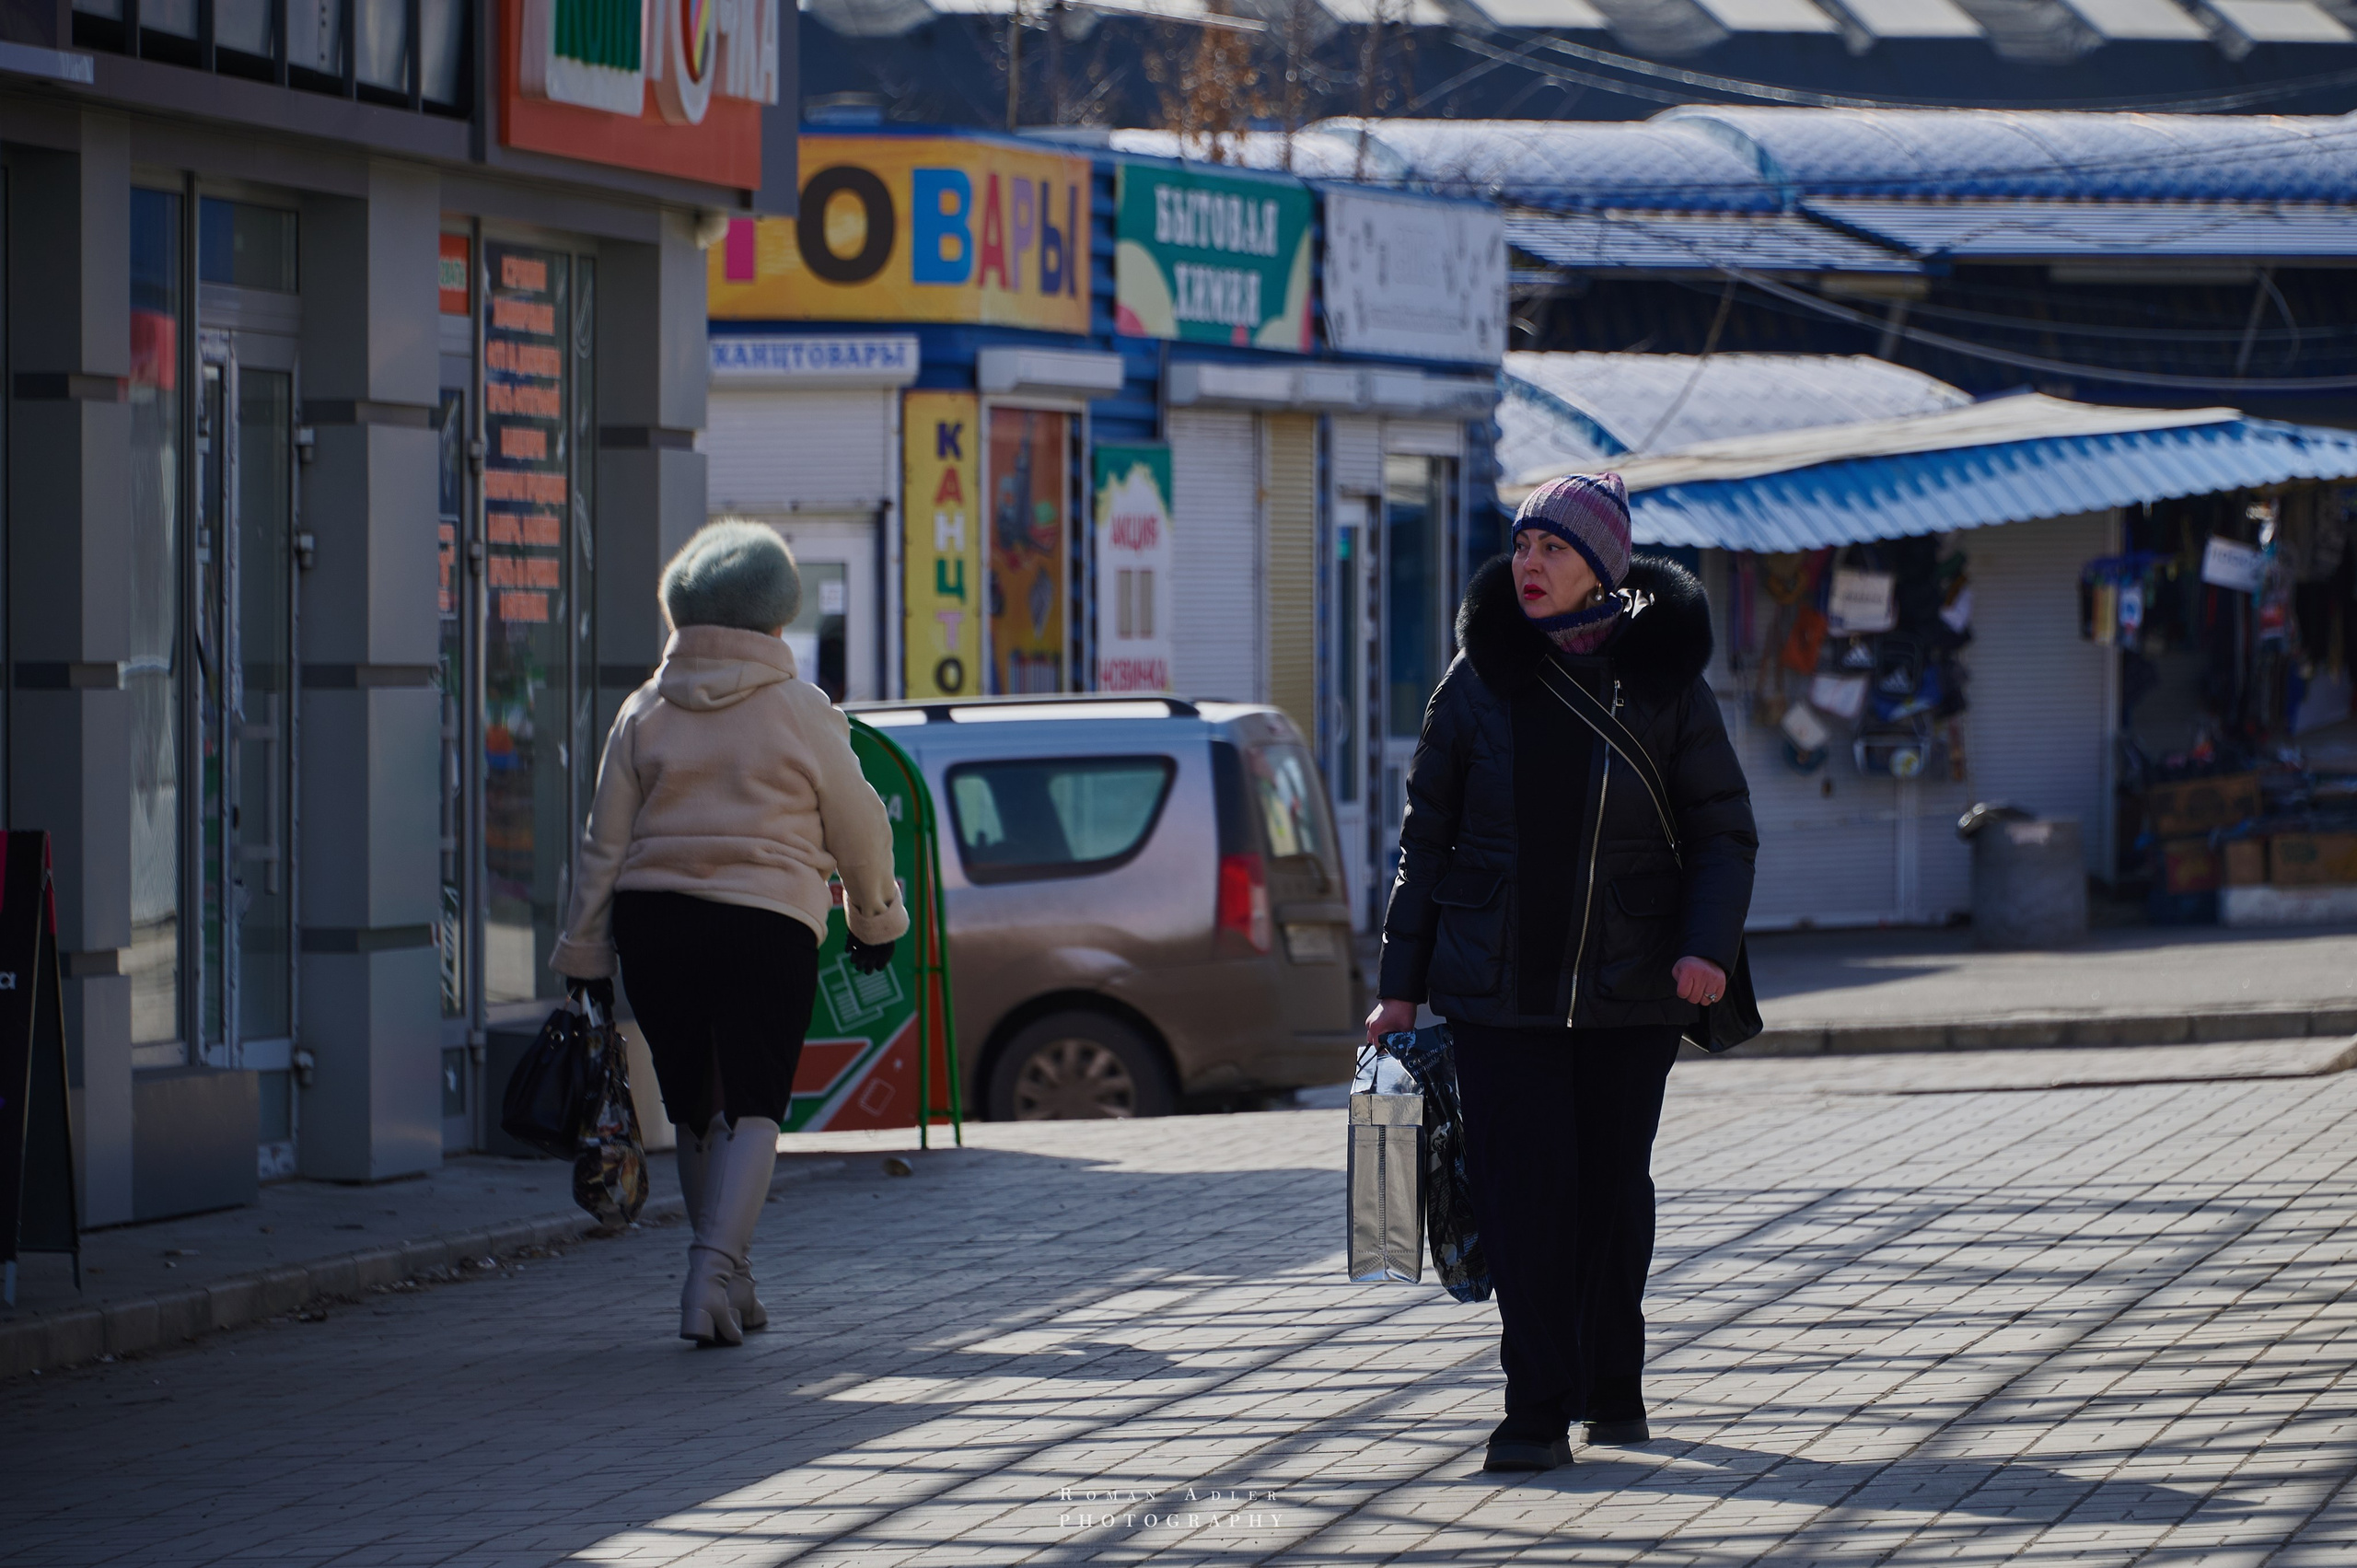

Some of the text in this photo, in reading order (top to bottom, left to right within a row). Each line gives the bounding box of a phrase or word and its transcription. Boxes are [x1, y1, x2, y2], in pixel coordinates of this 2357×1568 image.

[1155, 183, 1279, 258] БЫТОВАЯ
[1174, 262, 1261, 327] ХИМИЯ
[712, 342, 906, 372] КАНЦТОВАРЫ
[1109, 515, 1159, 555] АКЦИЯ
